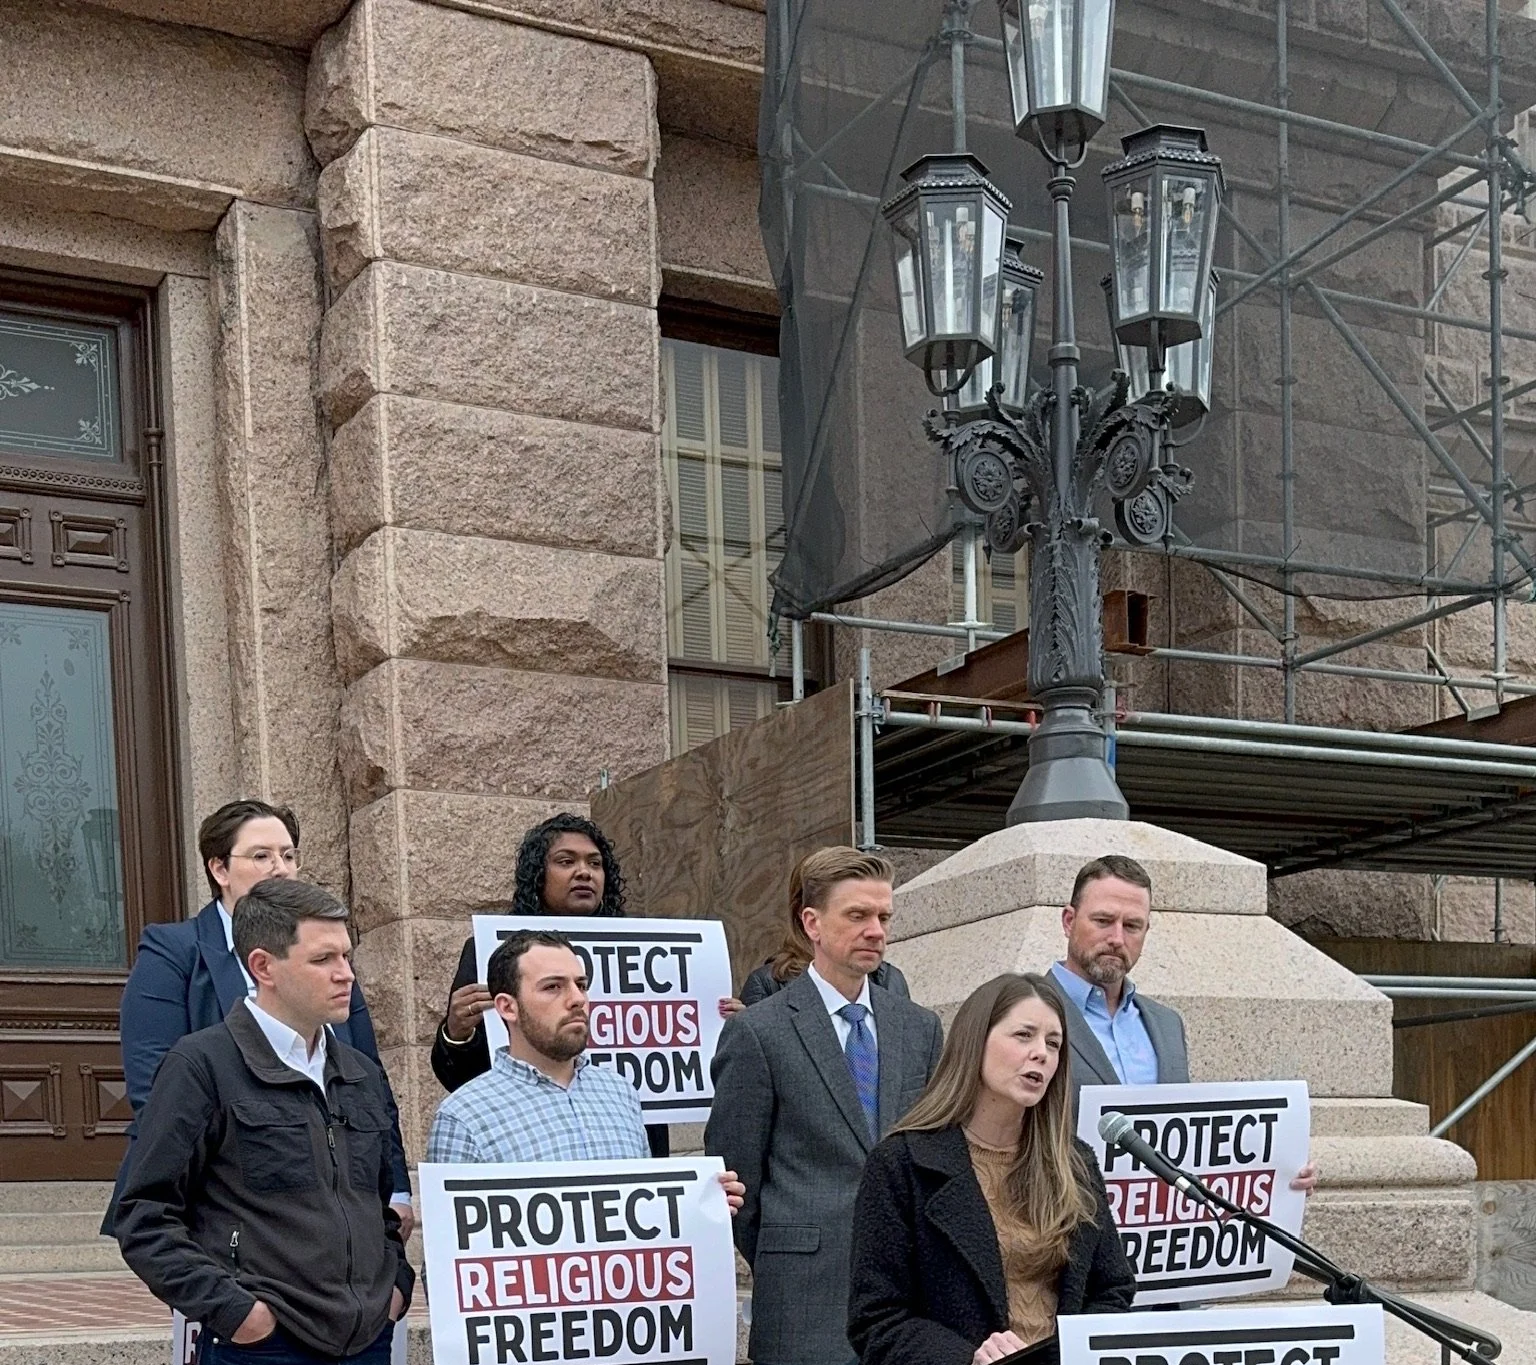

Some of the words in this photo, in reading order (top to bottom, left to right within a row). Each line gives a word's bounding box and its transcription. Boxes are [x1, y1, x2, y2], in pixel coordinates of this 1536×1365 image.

[573, 946, 692, 993] OTECT
[590, 1004, 698, 1045] GIOUS
[453, 1186, 685, 1250] PROTECT
[1118, 1220, 1266, 1276] REEDOM
[458, 1250, 692, 1309] RELIGIOUS
[465, 1304, 693, 1365] FREEDOM
